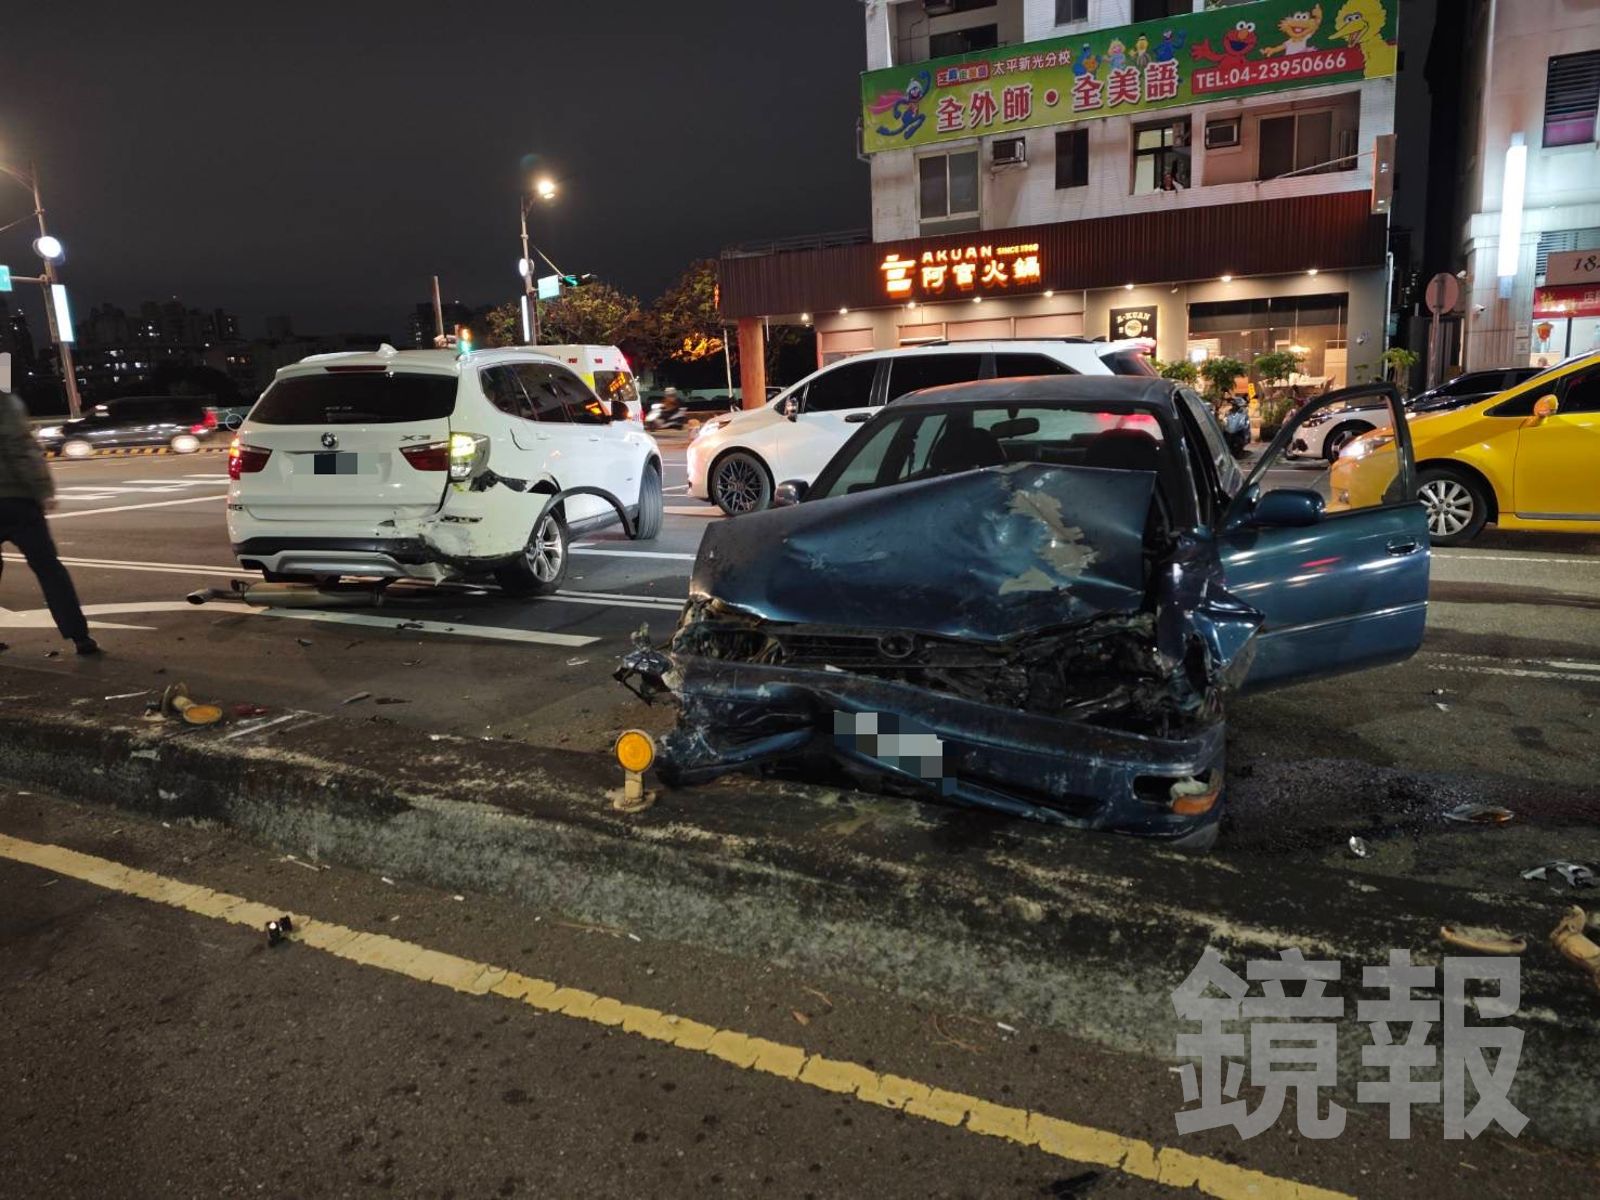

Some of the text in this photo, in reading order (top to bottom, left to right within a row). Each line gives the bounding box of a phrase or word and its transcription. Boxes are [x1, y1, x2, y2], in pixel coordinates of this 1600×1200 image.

[992, 49, 1072, 76] 太平新光分校
[1196, 52, 1347, 89] TEL:04-23950666
[921, 245, 992, 264] AKUAN
[1573, 255, 1600, 272] 18
[400, 434, 431, 442] X3
